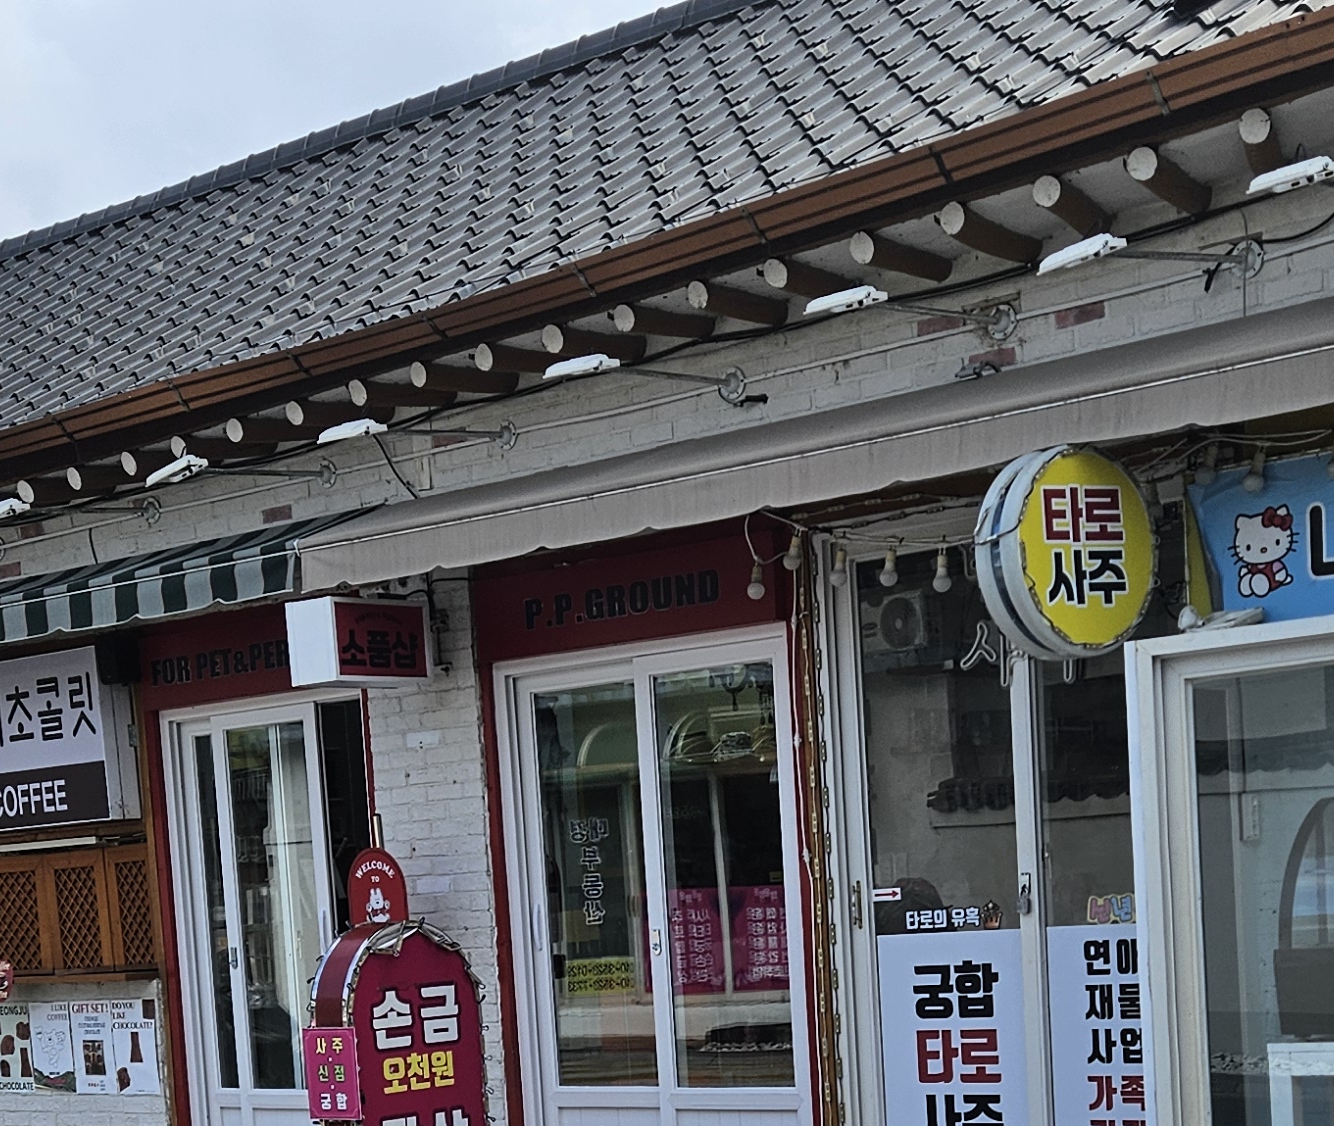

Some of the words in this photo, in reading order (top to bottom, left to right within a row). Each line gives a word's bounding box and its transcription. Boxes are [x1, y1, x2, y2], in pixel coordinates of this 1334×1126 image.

[1042, 483, 1125, 545] 타로
[1046, 548, 1128, 607] 사주
[341, 629, 417, 669] 소품샵
[151, 655, 192, 687] FOR
[354, 859, 396, 880] WELCOME
[905, 909, 948, 930] 타로의
[951, 906, 981, 928] 유혹
[72, 1002, 90, 1014] GIFT
[912, 960, 1000, 1020] 궁합
[1085, 983, 1141, 1020] 재물
[112, 1021, 153, 1030] CHOCOLATE?
[372, 983, 460, 1050] 손금
[315, 1036, 344, 1056] 사주
[915, 1028, 1003, 1084] 타로
[1087, 1028, 1144, 1065] 사업
[317, 1064, 346, 1083] 신점
[383, 1051, 455, 1094] 오천원
[320, 1092, 348, 1111] 궁합
[1087, 1075, 1146, 1112] 가족
